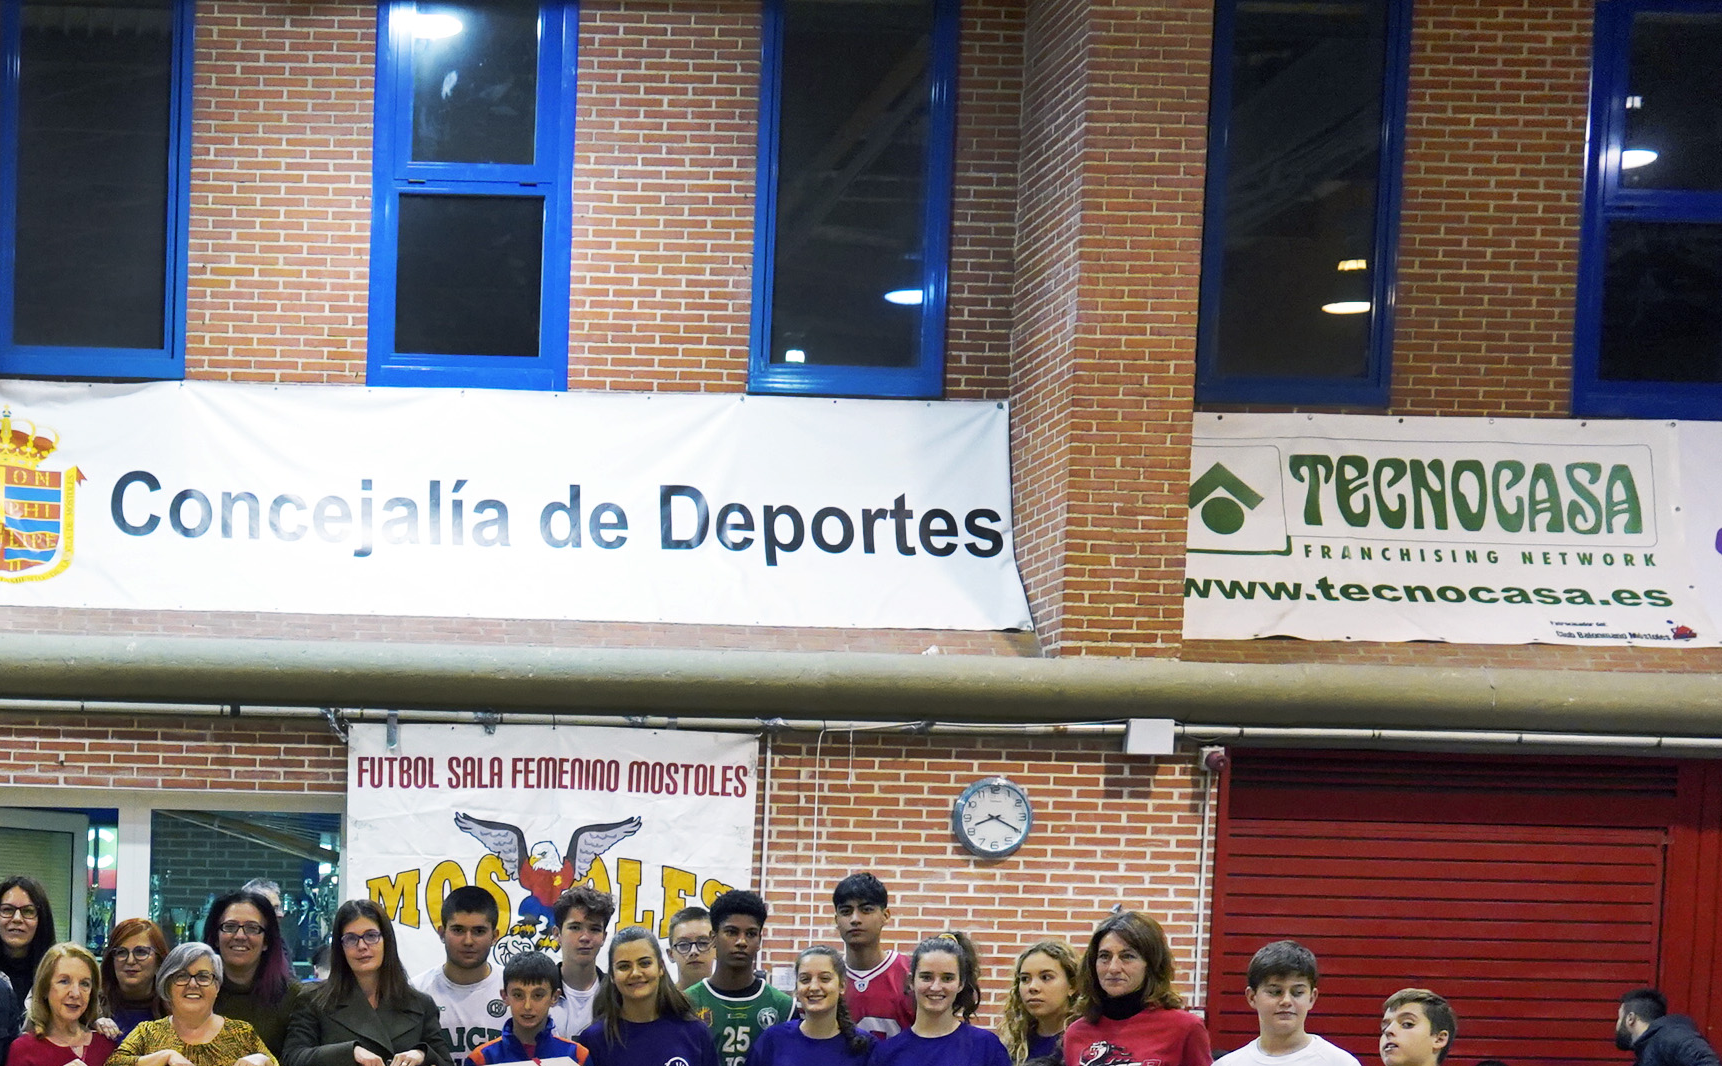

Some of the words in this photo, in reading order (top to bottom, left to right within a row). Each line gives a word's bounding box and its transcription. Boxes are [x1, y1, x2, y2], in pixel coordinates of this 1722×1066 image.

[1289, 454, 1643, 535] TECNOCASA
[110, 470, 511, 557] Concejalía
[539, 484, 629, 549] de
[659, 484, 1004, 567] Deportes
[1303, 544, 1500, 565] FRANCHISING
[1521, 551, 1658, 568] NETWORK
[1184, 576, 1674, 609] www.tecnocasa.es
[357, 756, 440, 790] FUTBOL
[447, 757, 503, 789] SALA
[511, 758, 620, 792] FEMENINO
[628, 761, 748, 798] MOSTOLES
[441, 1026, 503, 1053] AIC
[722, 1025, 751, 1053] 25
